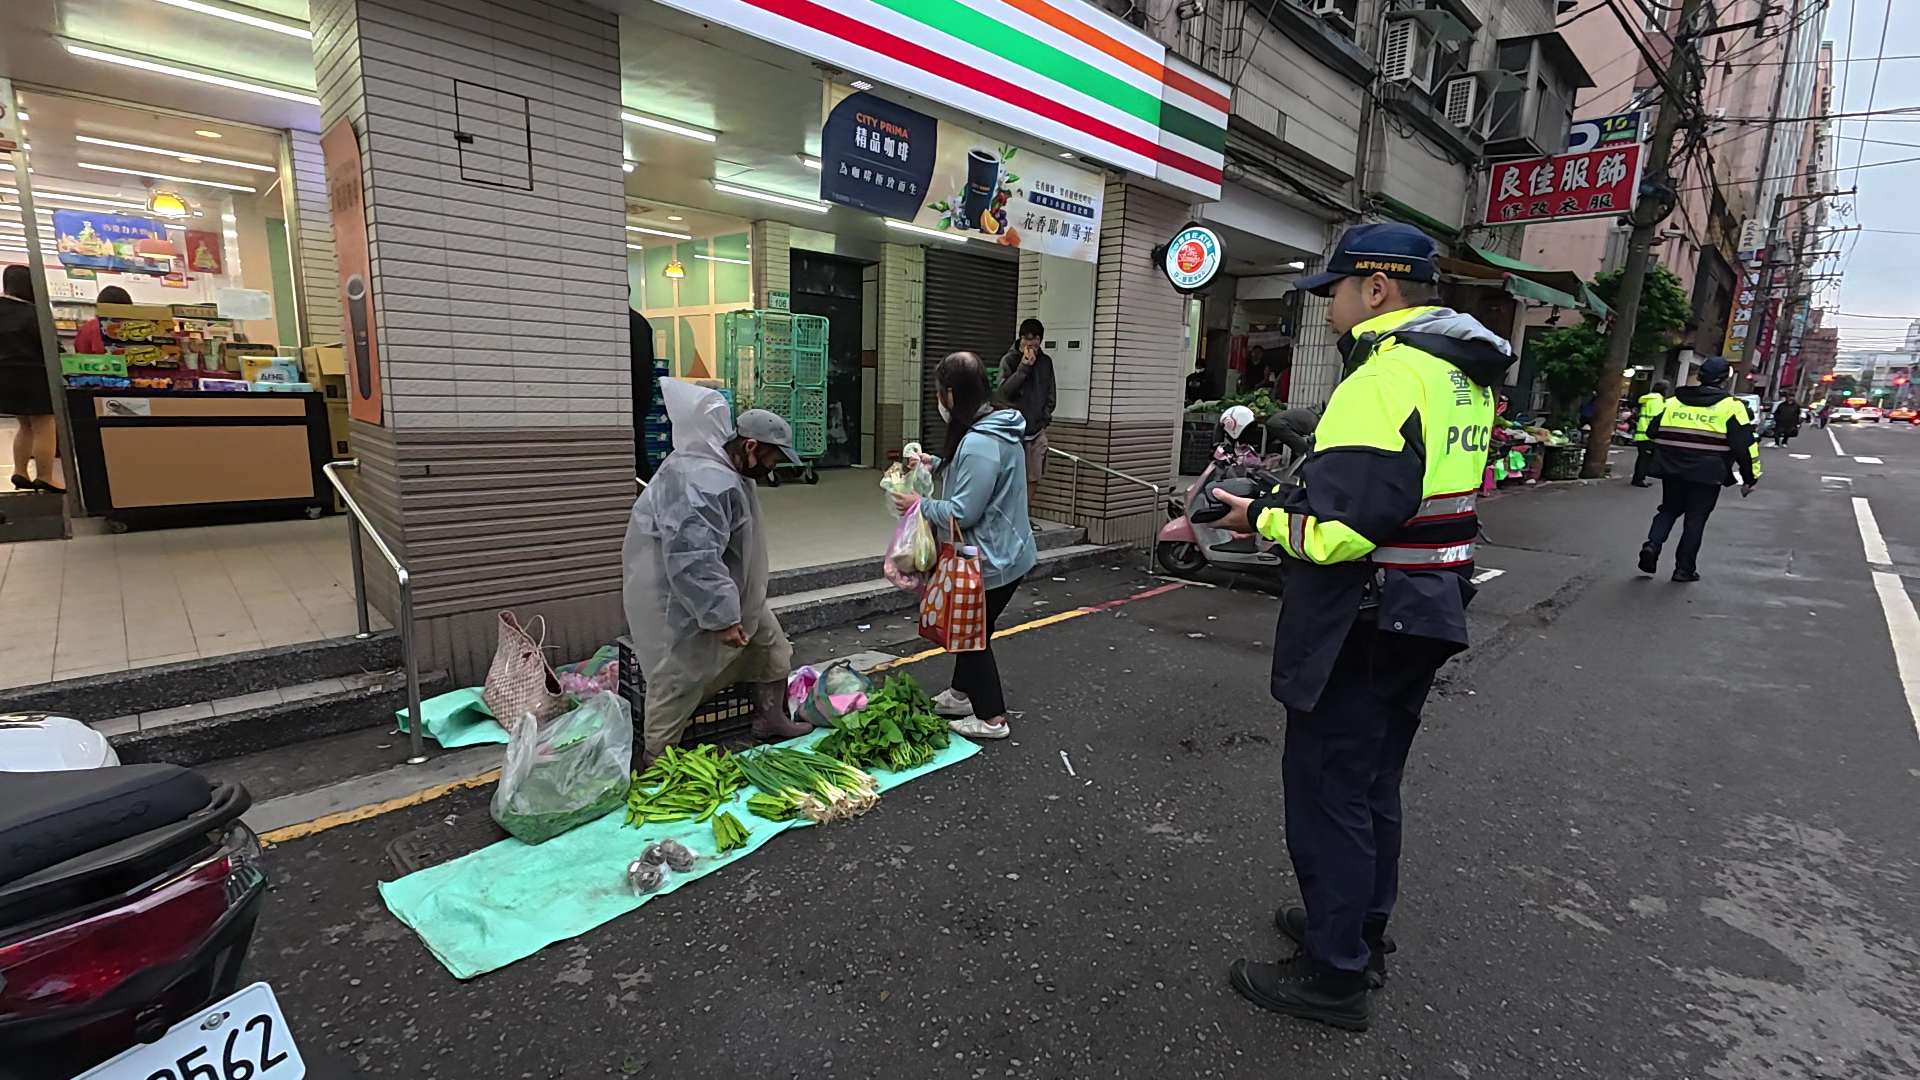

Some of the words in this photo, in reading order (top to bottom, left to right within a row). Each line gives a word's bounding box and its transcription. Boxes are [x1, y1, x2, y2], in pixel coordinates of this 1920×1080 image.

[856, 112, 878, 128] CITY
[879, 120, 909, 139] PRIMA
[855, 126, 910, 162] 精品咖啡
[1497, 152, 1628, 202] 良佳服飾
[1501, 193, 1614, 219] 修改衣服
[1671, 411, 1719, 424] POLICE
[144, 1013, 288, 1080] 562
